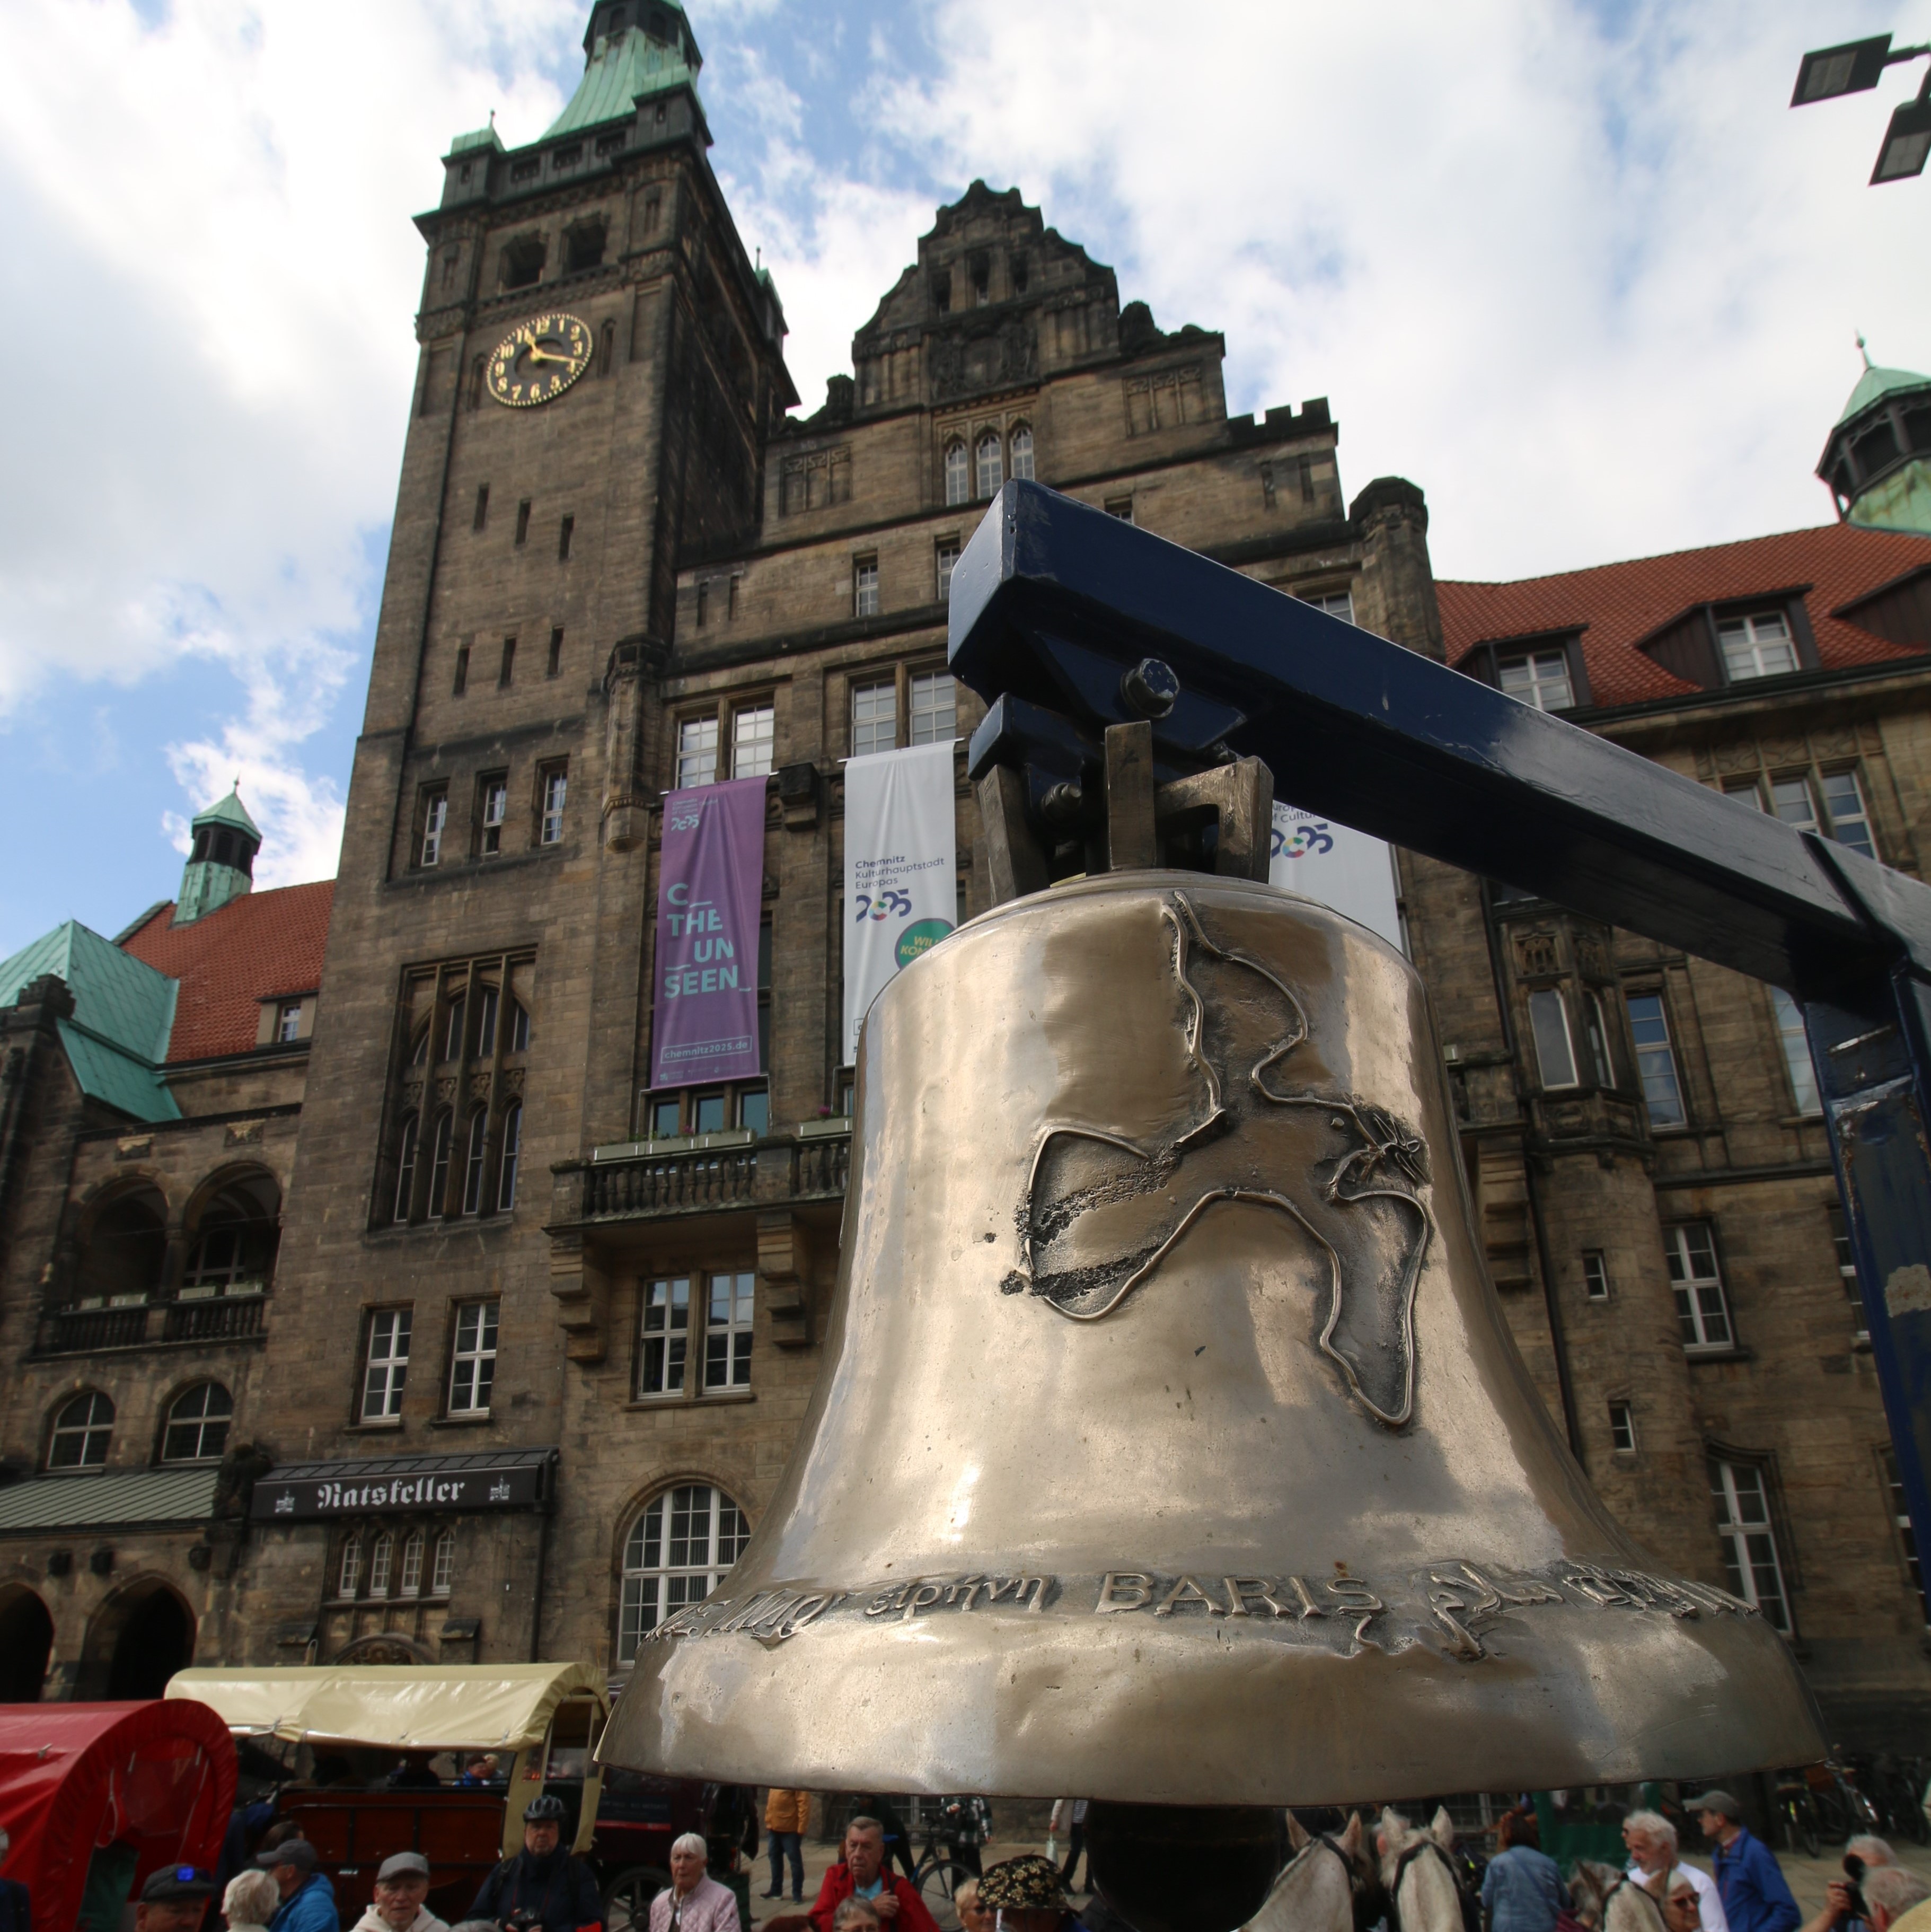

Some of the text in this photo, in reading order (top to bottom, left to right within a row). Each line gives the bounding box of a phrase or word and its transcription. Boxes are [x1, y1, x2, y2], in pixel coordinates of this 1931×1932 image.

[536, 318, 550, 335] 12
[570, 325, 580, 341] 2
[500, 344, 515, 359] 10
[573, 341, 583, 356] 3
[495, 361, 506, 377] 9
[497, 376, 508, 393] 8
[531, 383, 541, 399] 6
[550, 375, 560, 391] 5
[512, 384, 522, 400] 7
[856, 856, 905, 868] Chemnitz
[856, 857, 945, 879] Kulturhauptstadt
[856, 877, 898, 889] Europas
[666, 909, 723, 936] THE
[694, 937, 734, 962] UN
[665, 1041, 748, 1059] chemnitz2025.de
[318, 1477, 465, 1509] Ratskeller
